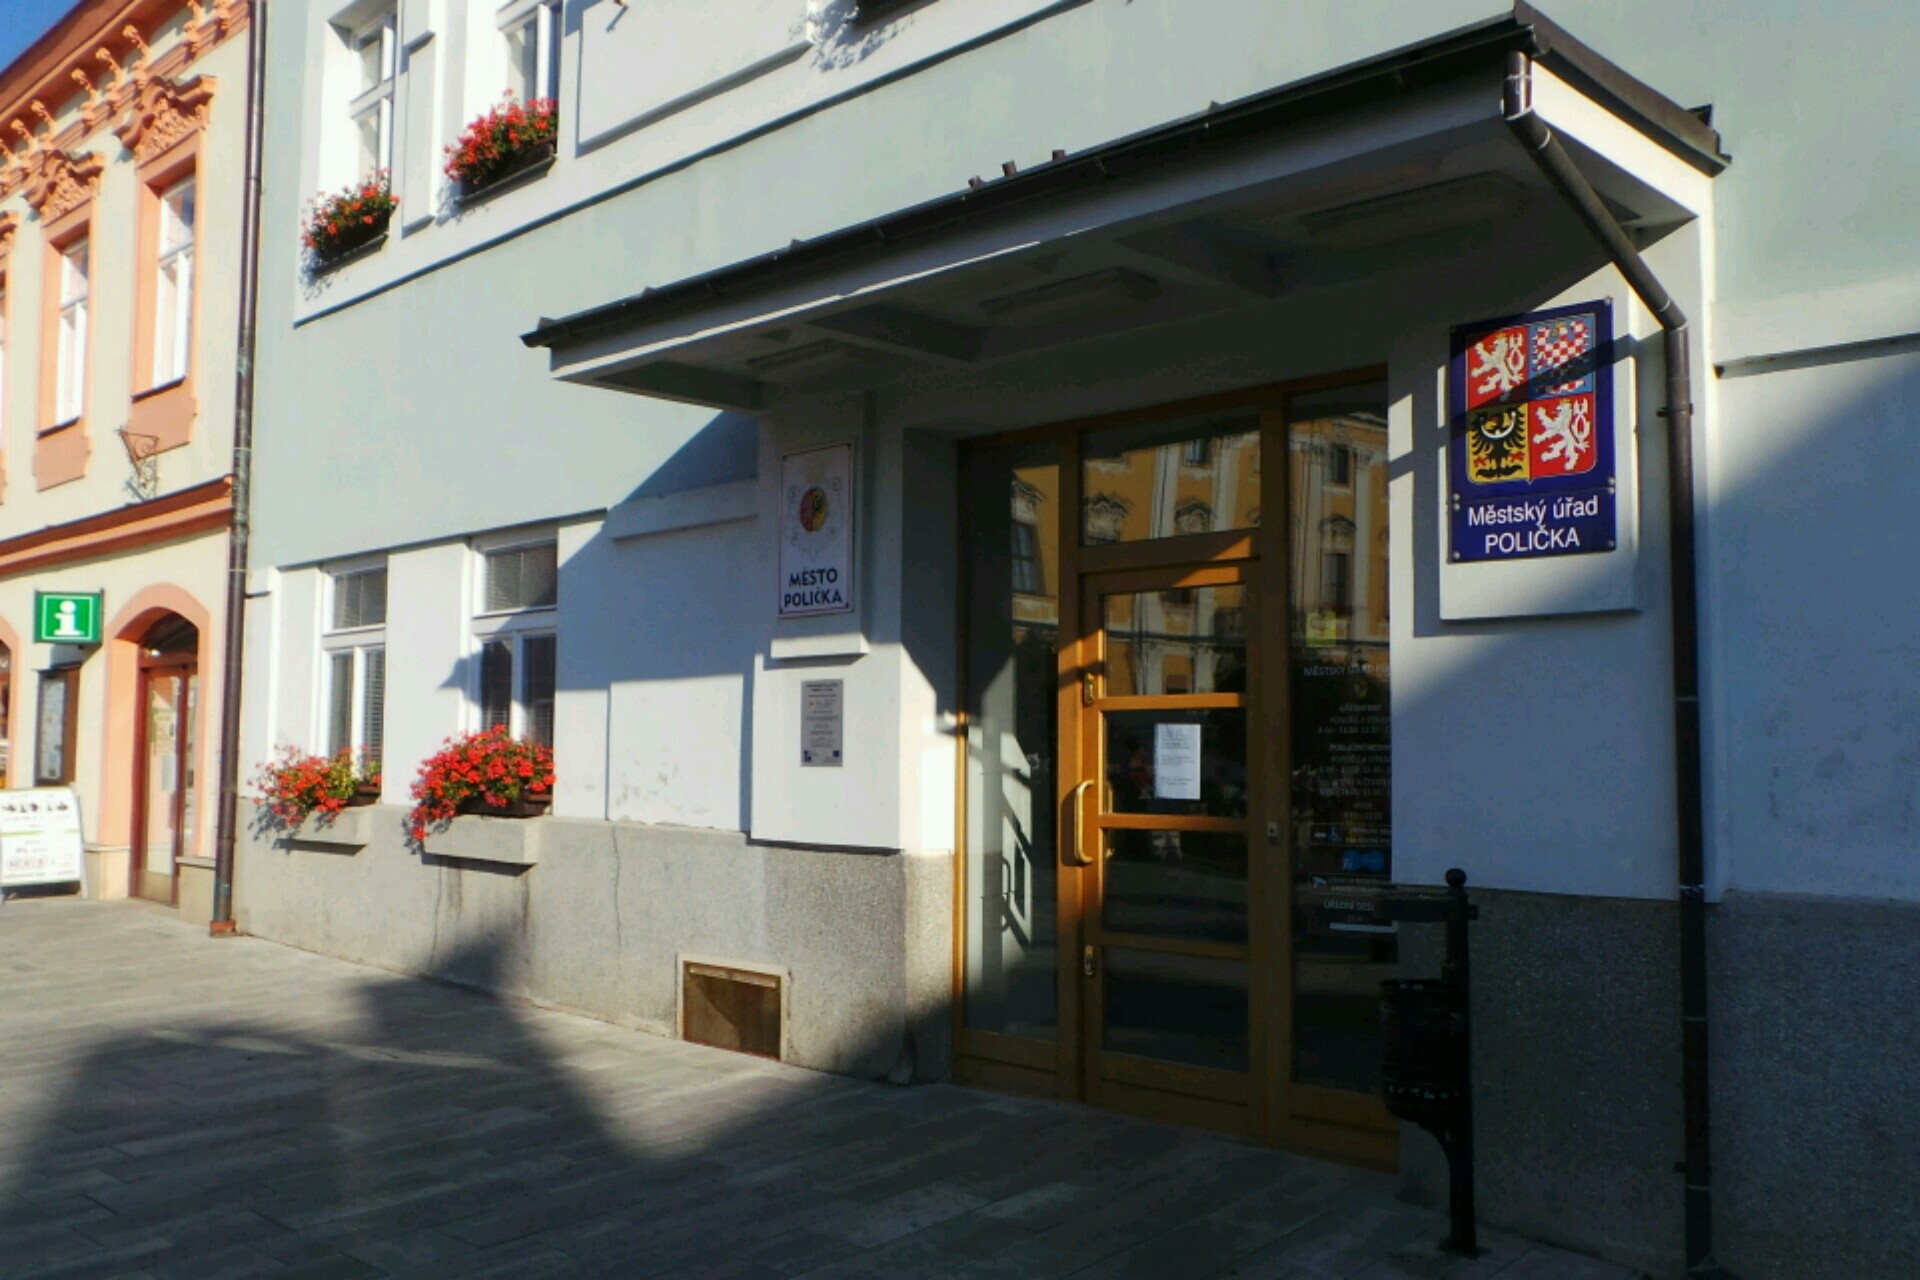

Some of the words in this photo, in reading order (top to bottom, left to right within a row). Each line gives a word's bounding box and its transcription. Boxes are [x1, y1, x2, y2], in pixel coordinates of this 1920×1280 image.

[1468, 499, 1547, 527] Městský
[1552, 495, 1599, 519] úřad
[1484, 524, 1580, 555] POLIČKA
[788, 566, 838, 588] MĚSTO
[784, 586, 843, 608] POLIČKA
